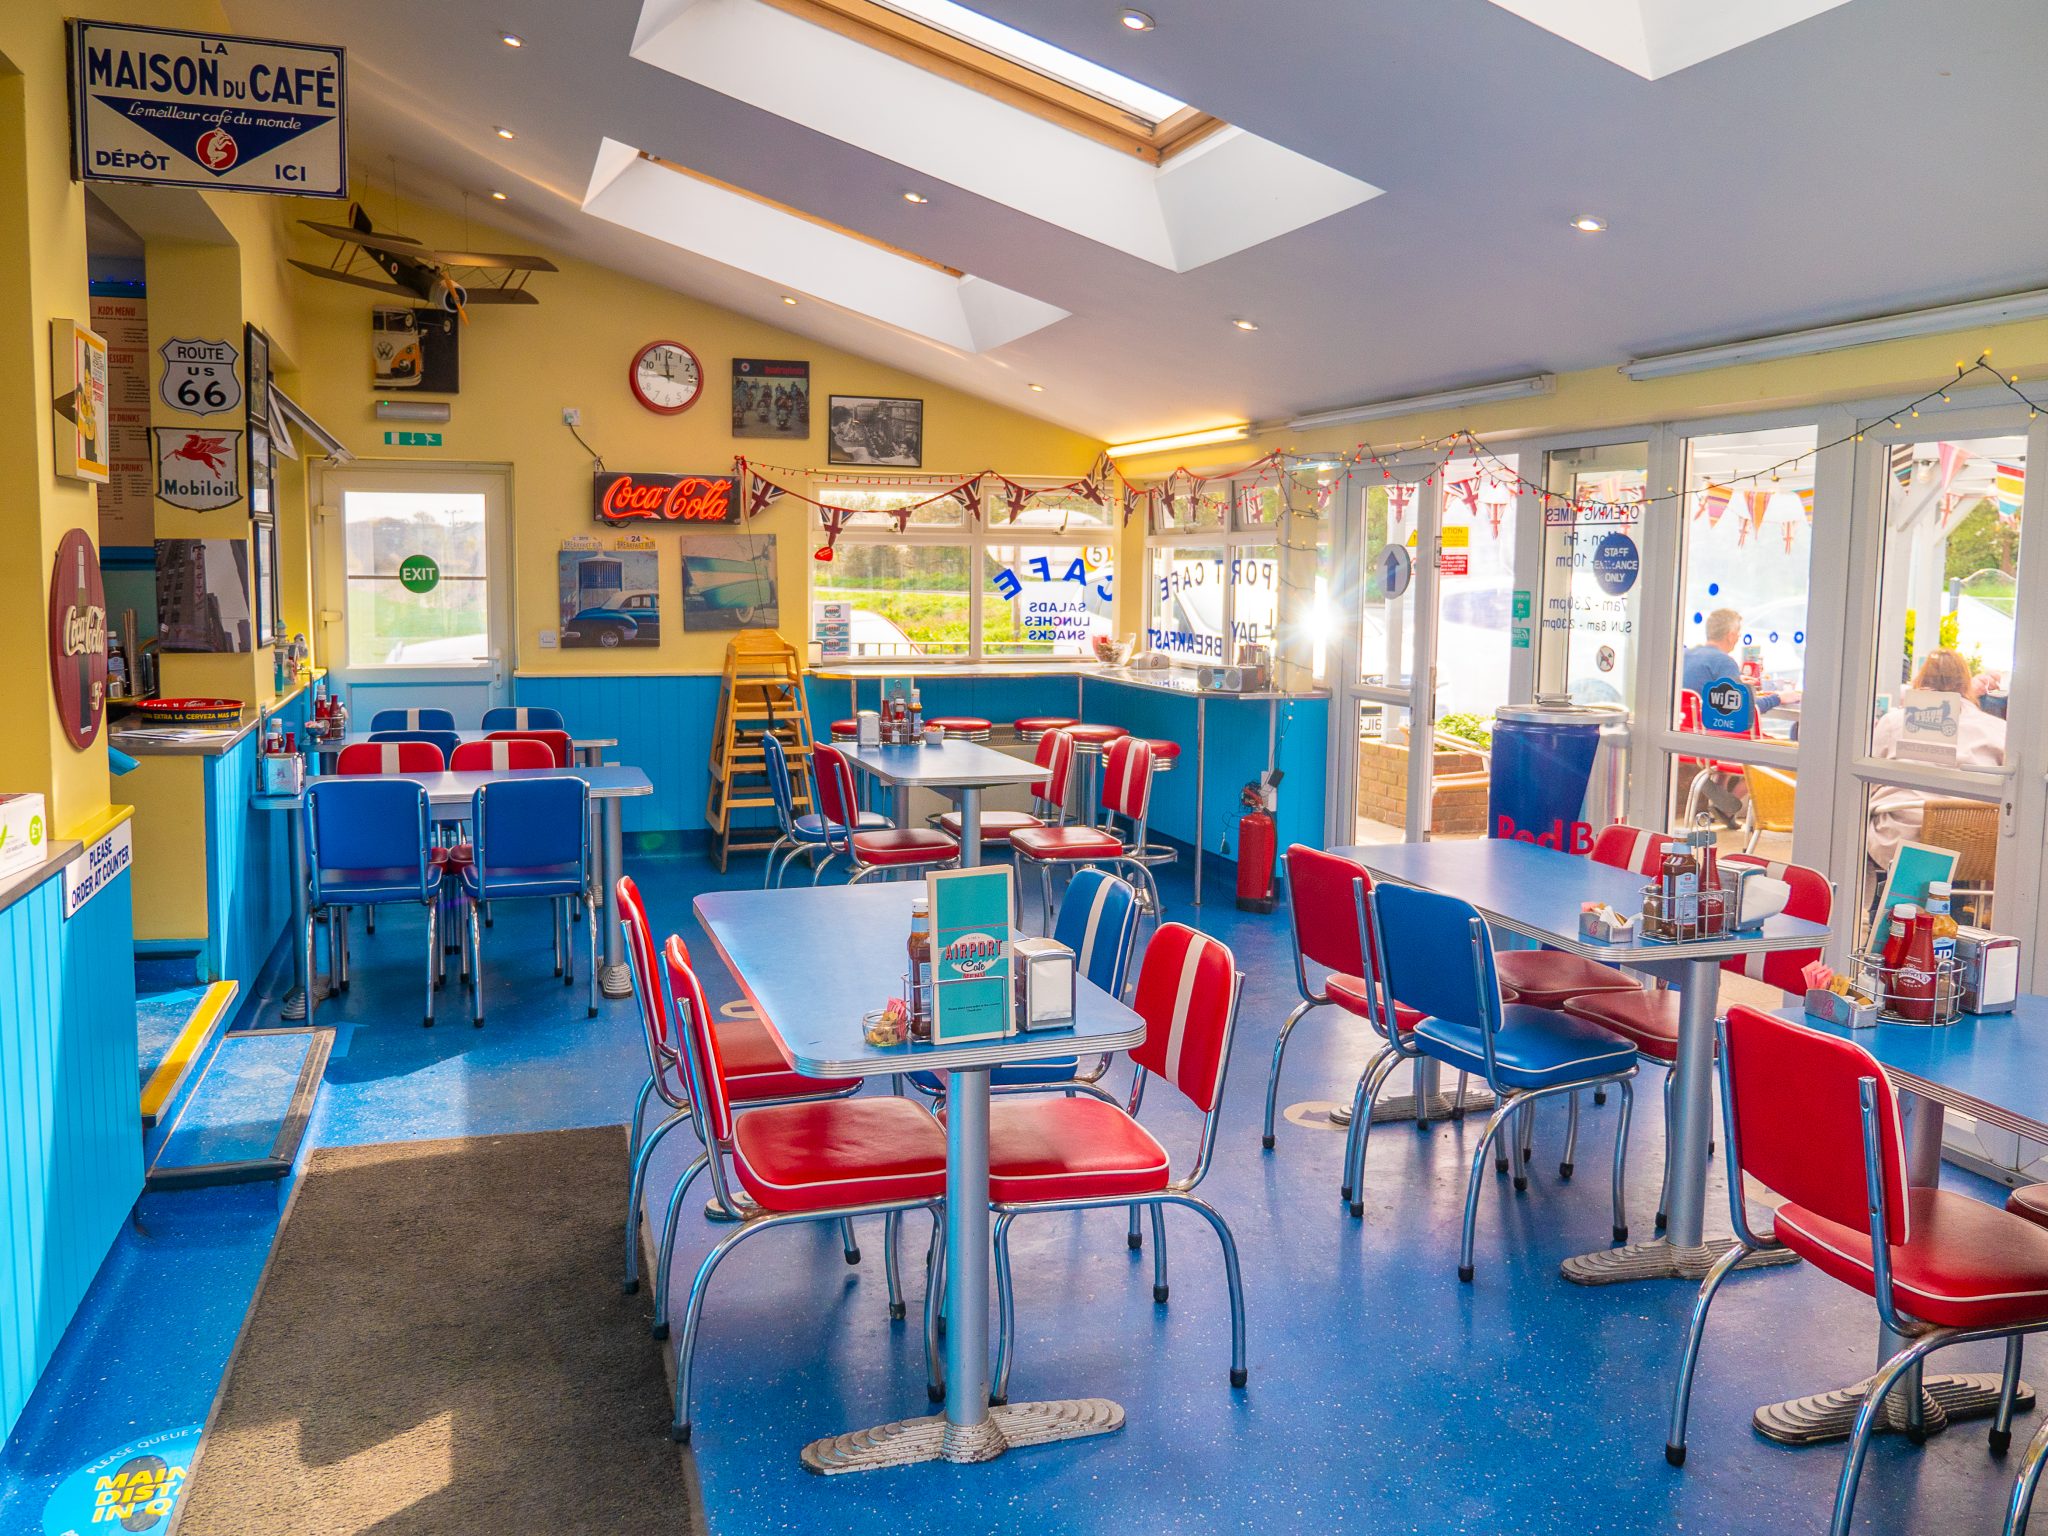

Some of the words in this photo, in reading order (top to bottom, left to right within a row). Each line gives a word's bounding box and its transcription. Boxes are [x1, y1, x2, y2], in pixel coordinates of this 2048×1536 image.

[200, 40, 228, 56] LA
[88, 46, 219, 97] MAISON
[223, 79, 246, 100] DU
[249, 64, 336, 109] CAFÉ
[127, 101, 144, 115] Le
[144, 106, 200, 121] meilleur
[202, 109, 231, 127] café
[233, 114, 252, 126] du
[256, 116, 302, 130] monde
[96, 148, 170, 171] DÉPÔT
[275, 164, 306, 182] ICI
[97, 305, 113, 316] KIDS
[115, 306, 136, 317] MENU
[107, 353, 134, 364] ESSERTS
[177, 346, 224, 361] ROUTE
[655, 352, 662, 362] 11
[187, 366, 215, 377] US
[646, 361, 655, 370] 10
[684, 363, 691, 373] 2
[178, 379, 227, 408] 66
[109, 463, 120, 472] OLD
[164, 479, 235, 498] Mobiloil
[602, 475, 733, 520] Coca-Cola
[631, 535, 641, 543] 24
[1092, 546, 1103, 563] 5
[1603, 547, 1629, 558] STAFF
[402, 567, 436, 581] EXIT
[1604, 572, 1626, 583] ONLY
[1712, 717, 1735, 729] ZONE
[89, 836, 113, 870] PLEASE
[71, 875, 94, 909] ORDER
[94, 866, 102, 890] AT
[102, 845, 130, 881] COUNTER
[945, 939, 1003, 961] AIRPORT
[86, 1447, 136, 1474] PLEASE
[137, 1429, 190, 1449] QUEUE
[94, 1466, 189, 1492] MAIN
[94, 1480, 184, 1507] DIST
[91, 1502, 136, 1524] IN
